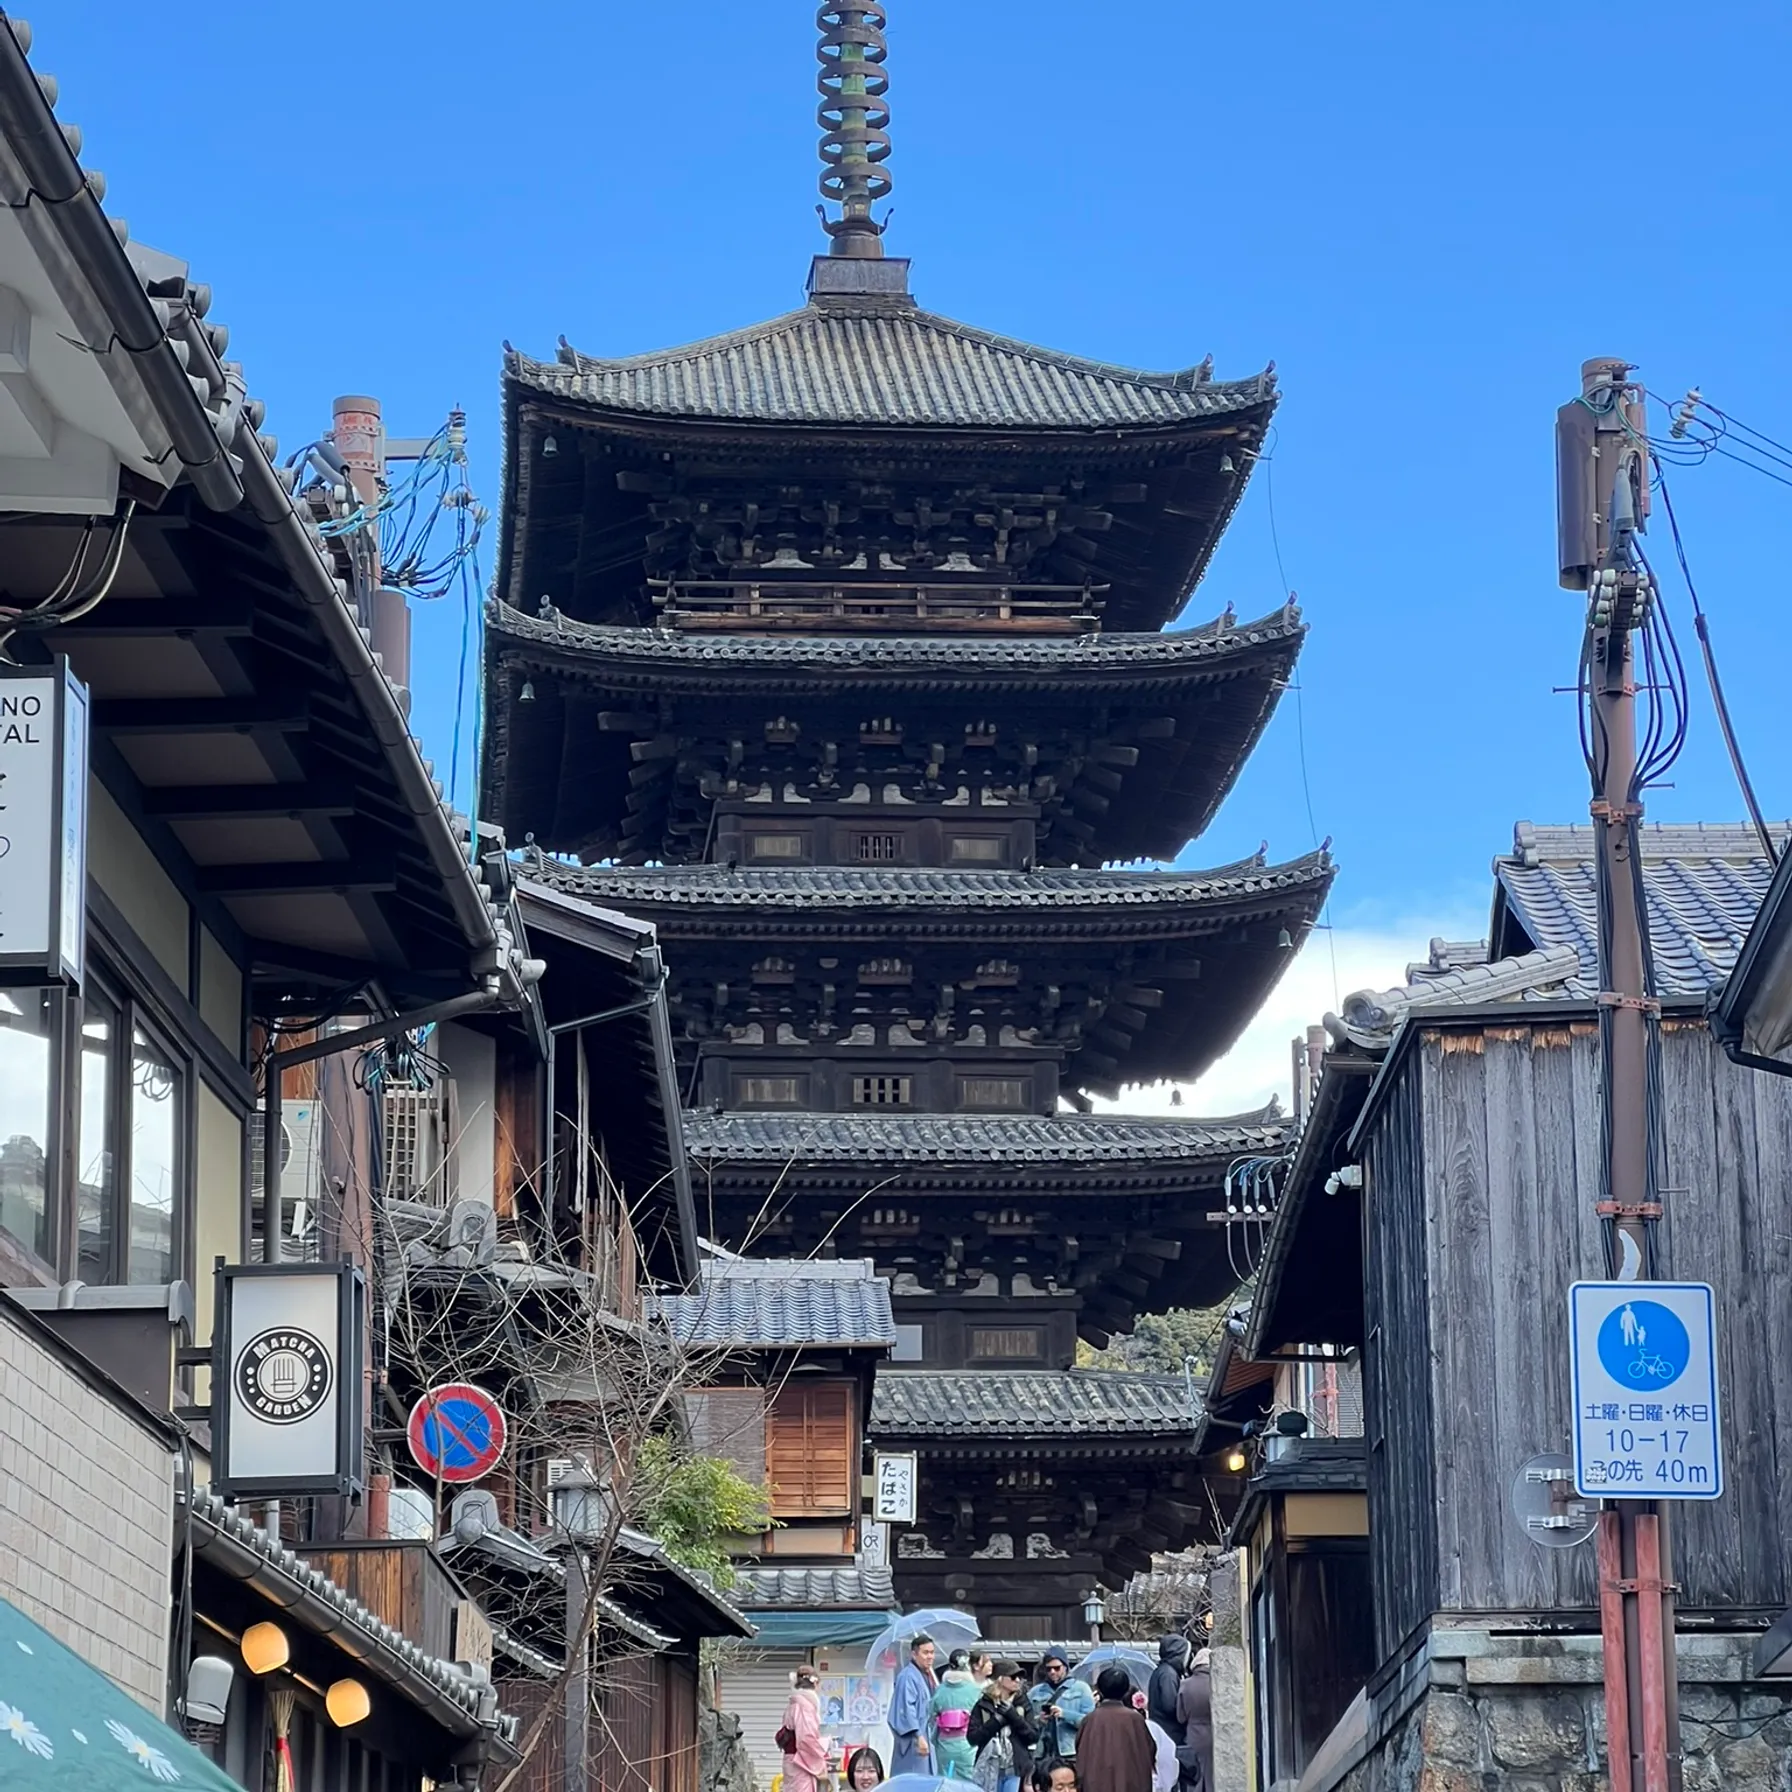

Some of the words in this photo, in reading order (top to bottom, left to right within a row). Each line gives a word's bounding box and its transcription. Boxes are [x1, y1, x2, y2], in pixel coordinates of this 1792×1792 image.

[0, 723, 40, 744] AL
[252, 1336, 316, 1359] MATCHA
[255, 1394, 313, 1415] GARDEN
[1655, 1459, 1708, 1483] 40m
